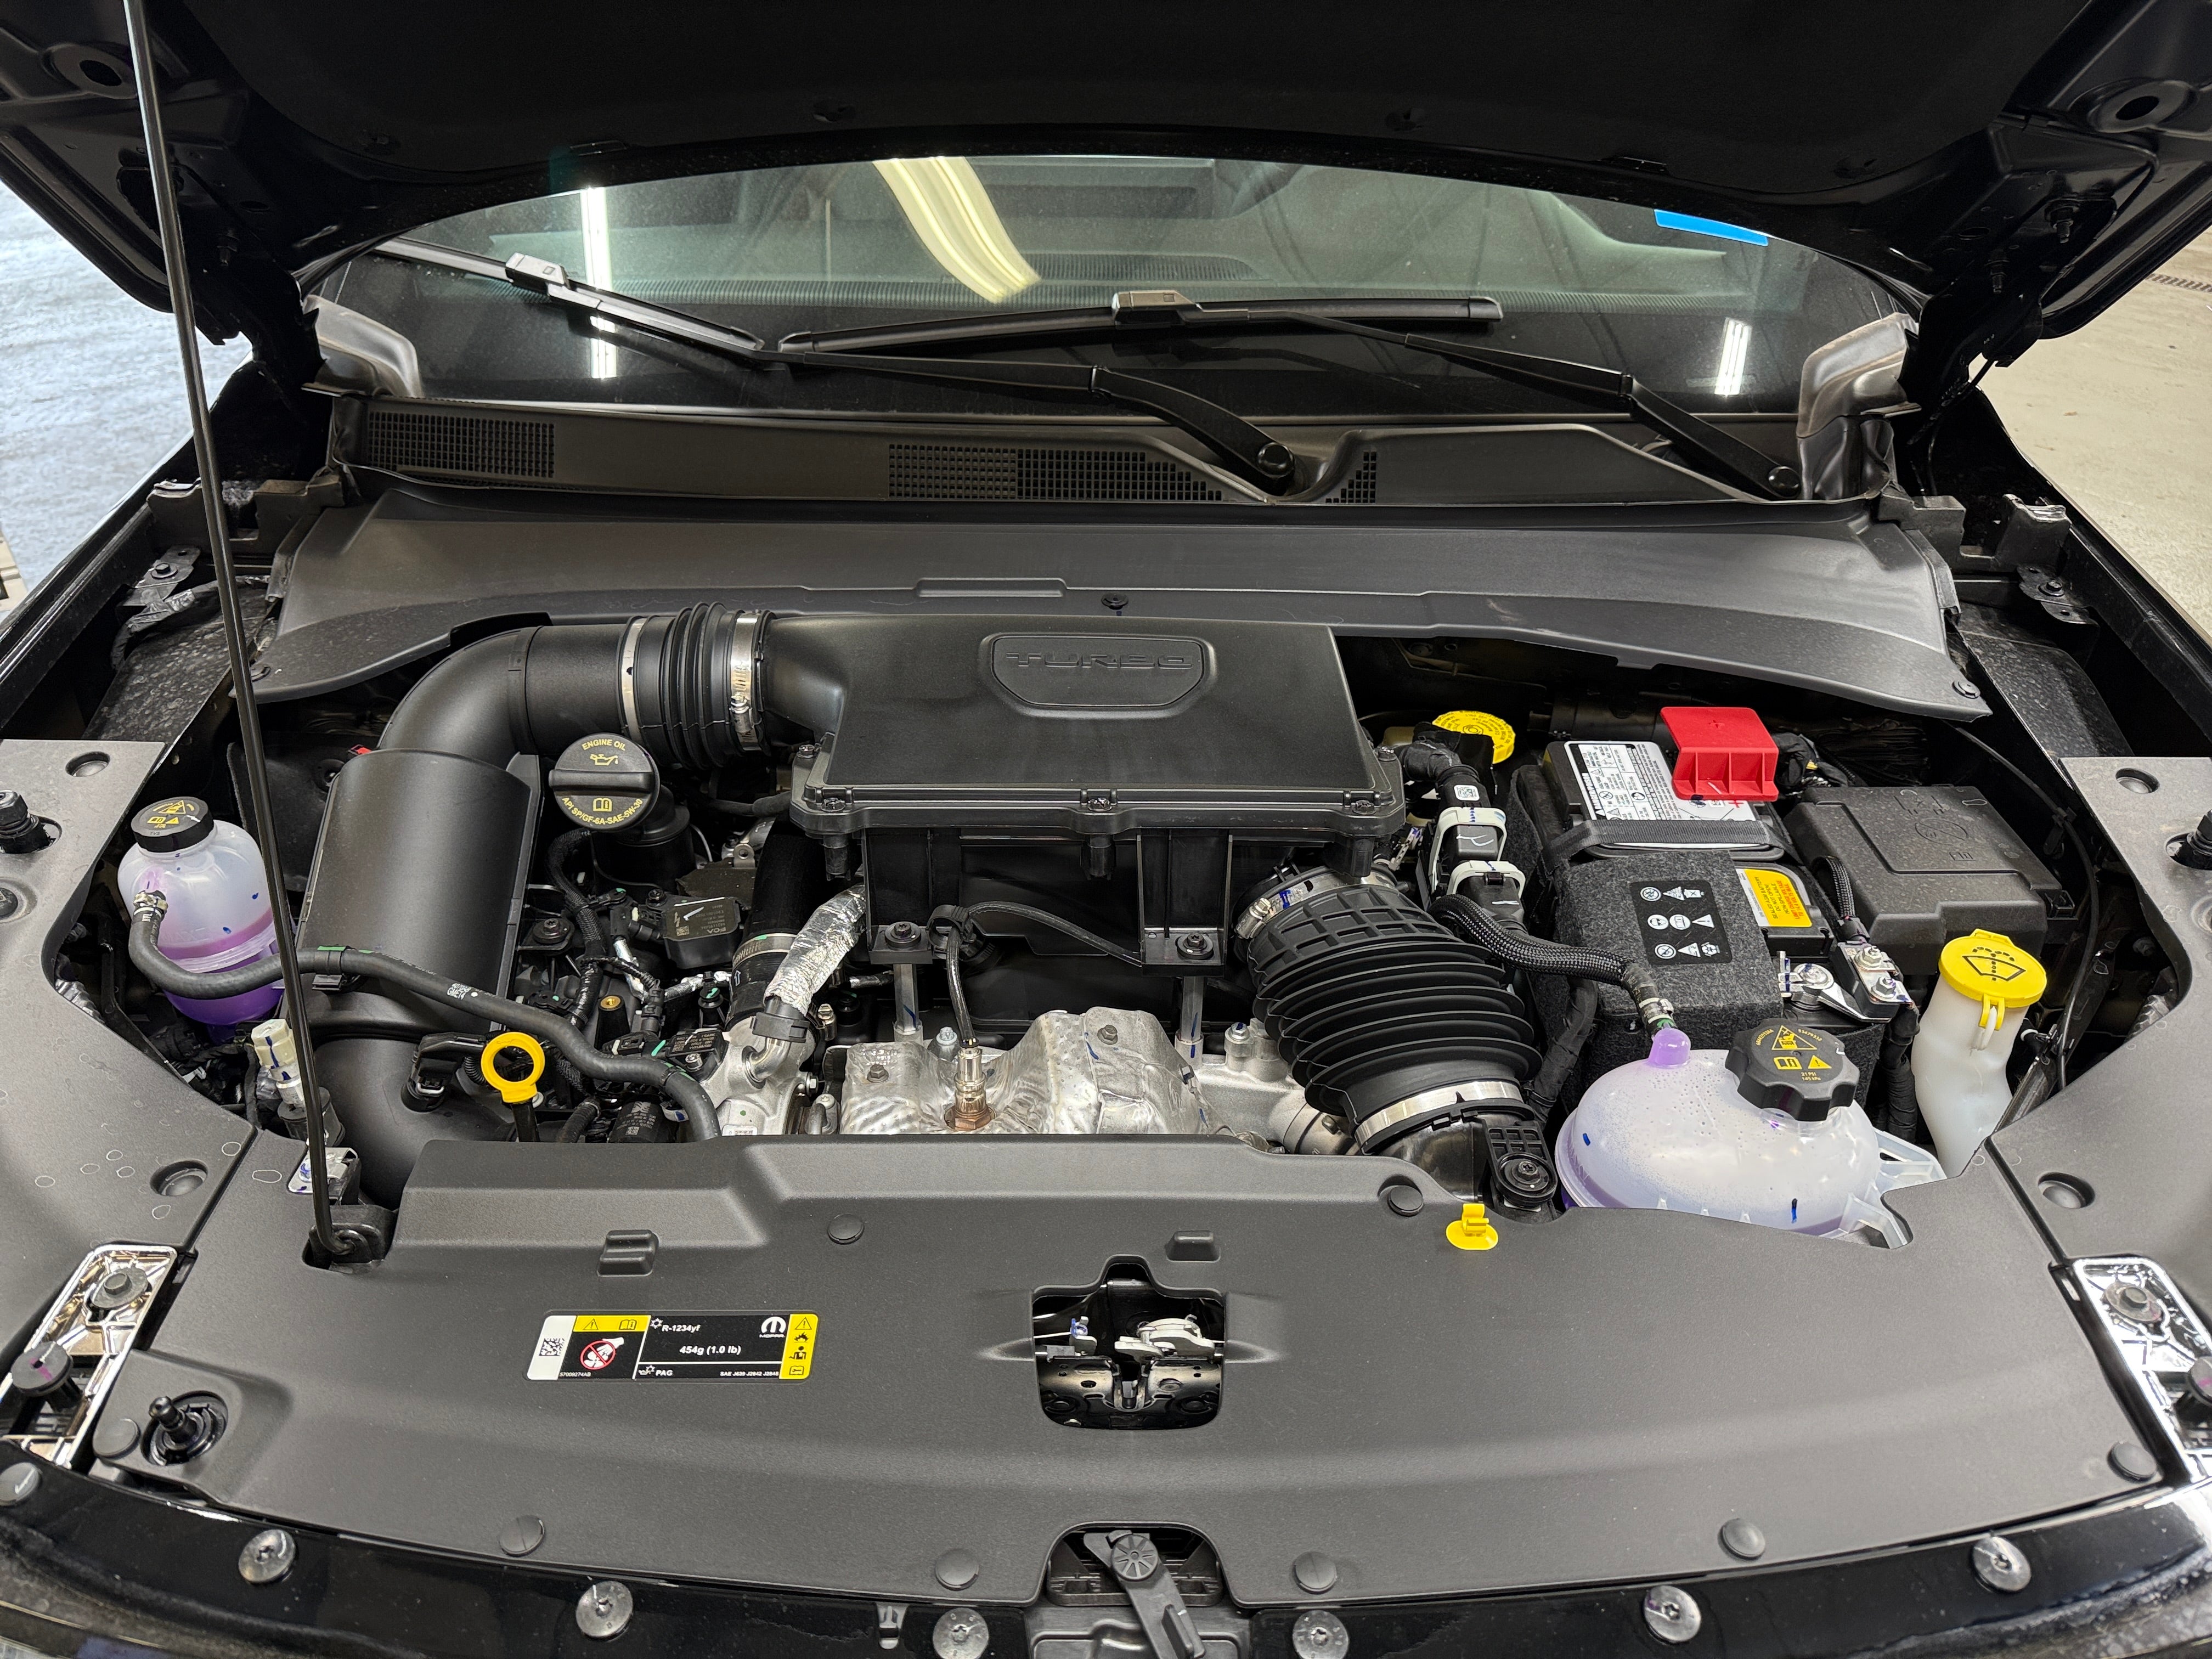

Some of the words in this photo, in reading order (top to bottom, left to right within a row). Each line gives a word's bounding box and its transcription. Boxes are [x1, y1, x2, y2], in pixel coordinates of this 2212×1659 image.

[1006, 651, 1193, 669] TURBO
[582, 738, 612, 751] ENGINE
[613, 741, 626, 751] OIL
[562, 797, 574, 809] API
[572, 798, 643, 825] SP/GF-6A-SAE-5W-30
[1754, 877, 1764, 894] BATTERY
[1767, 904, 1779, 919] SEALED
[662, 1324, 701, 1333] R-1234yf
[679, 1346, 704, 1355] 454g
[707, 1346, 725, 1355] (1.0
[728, 1346, 741, 1355] lb)
